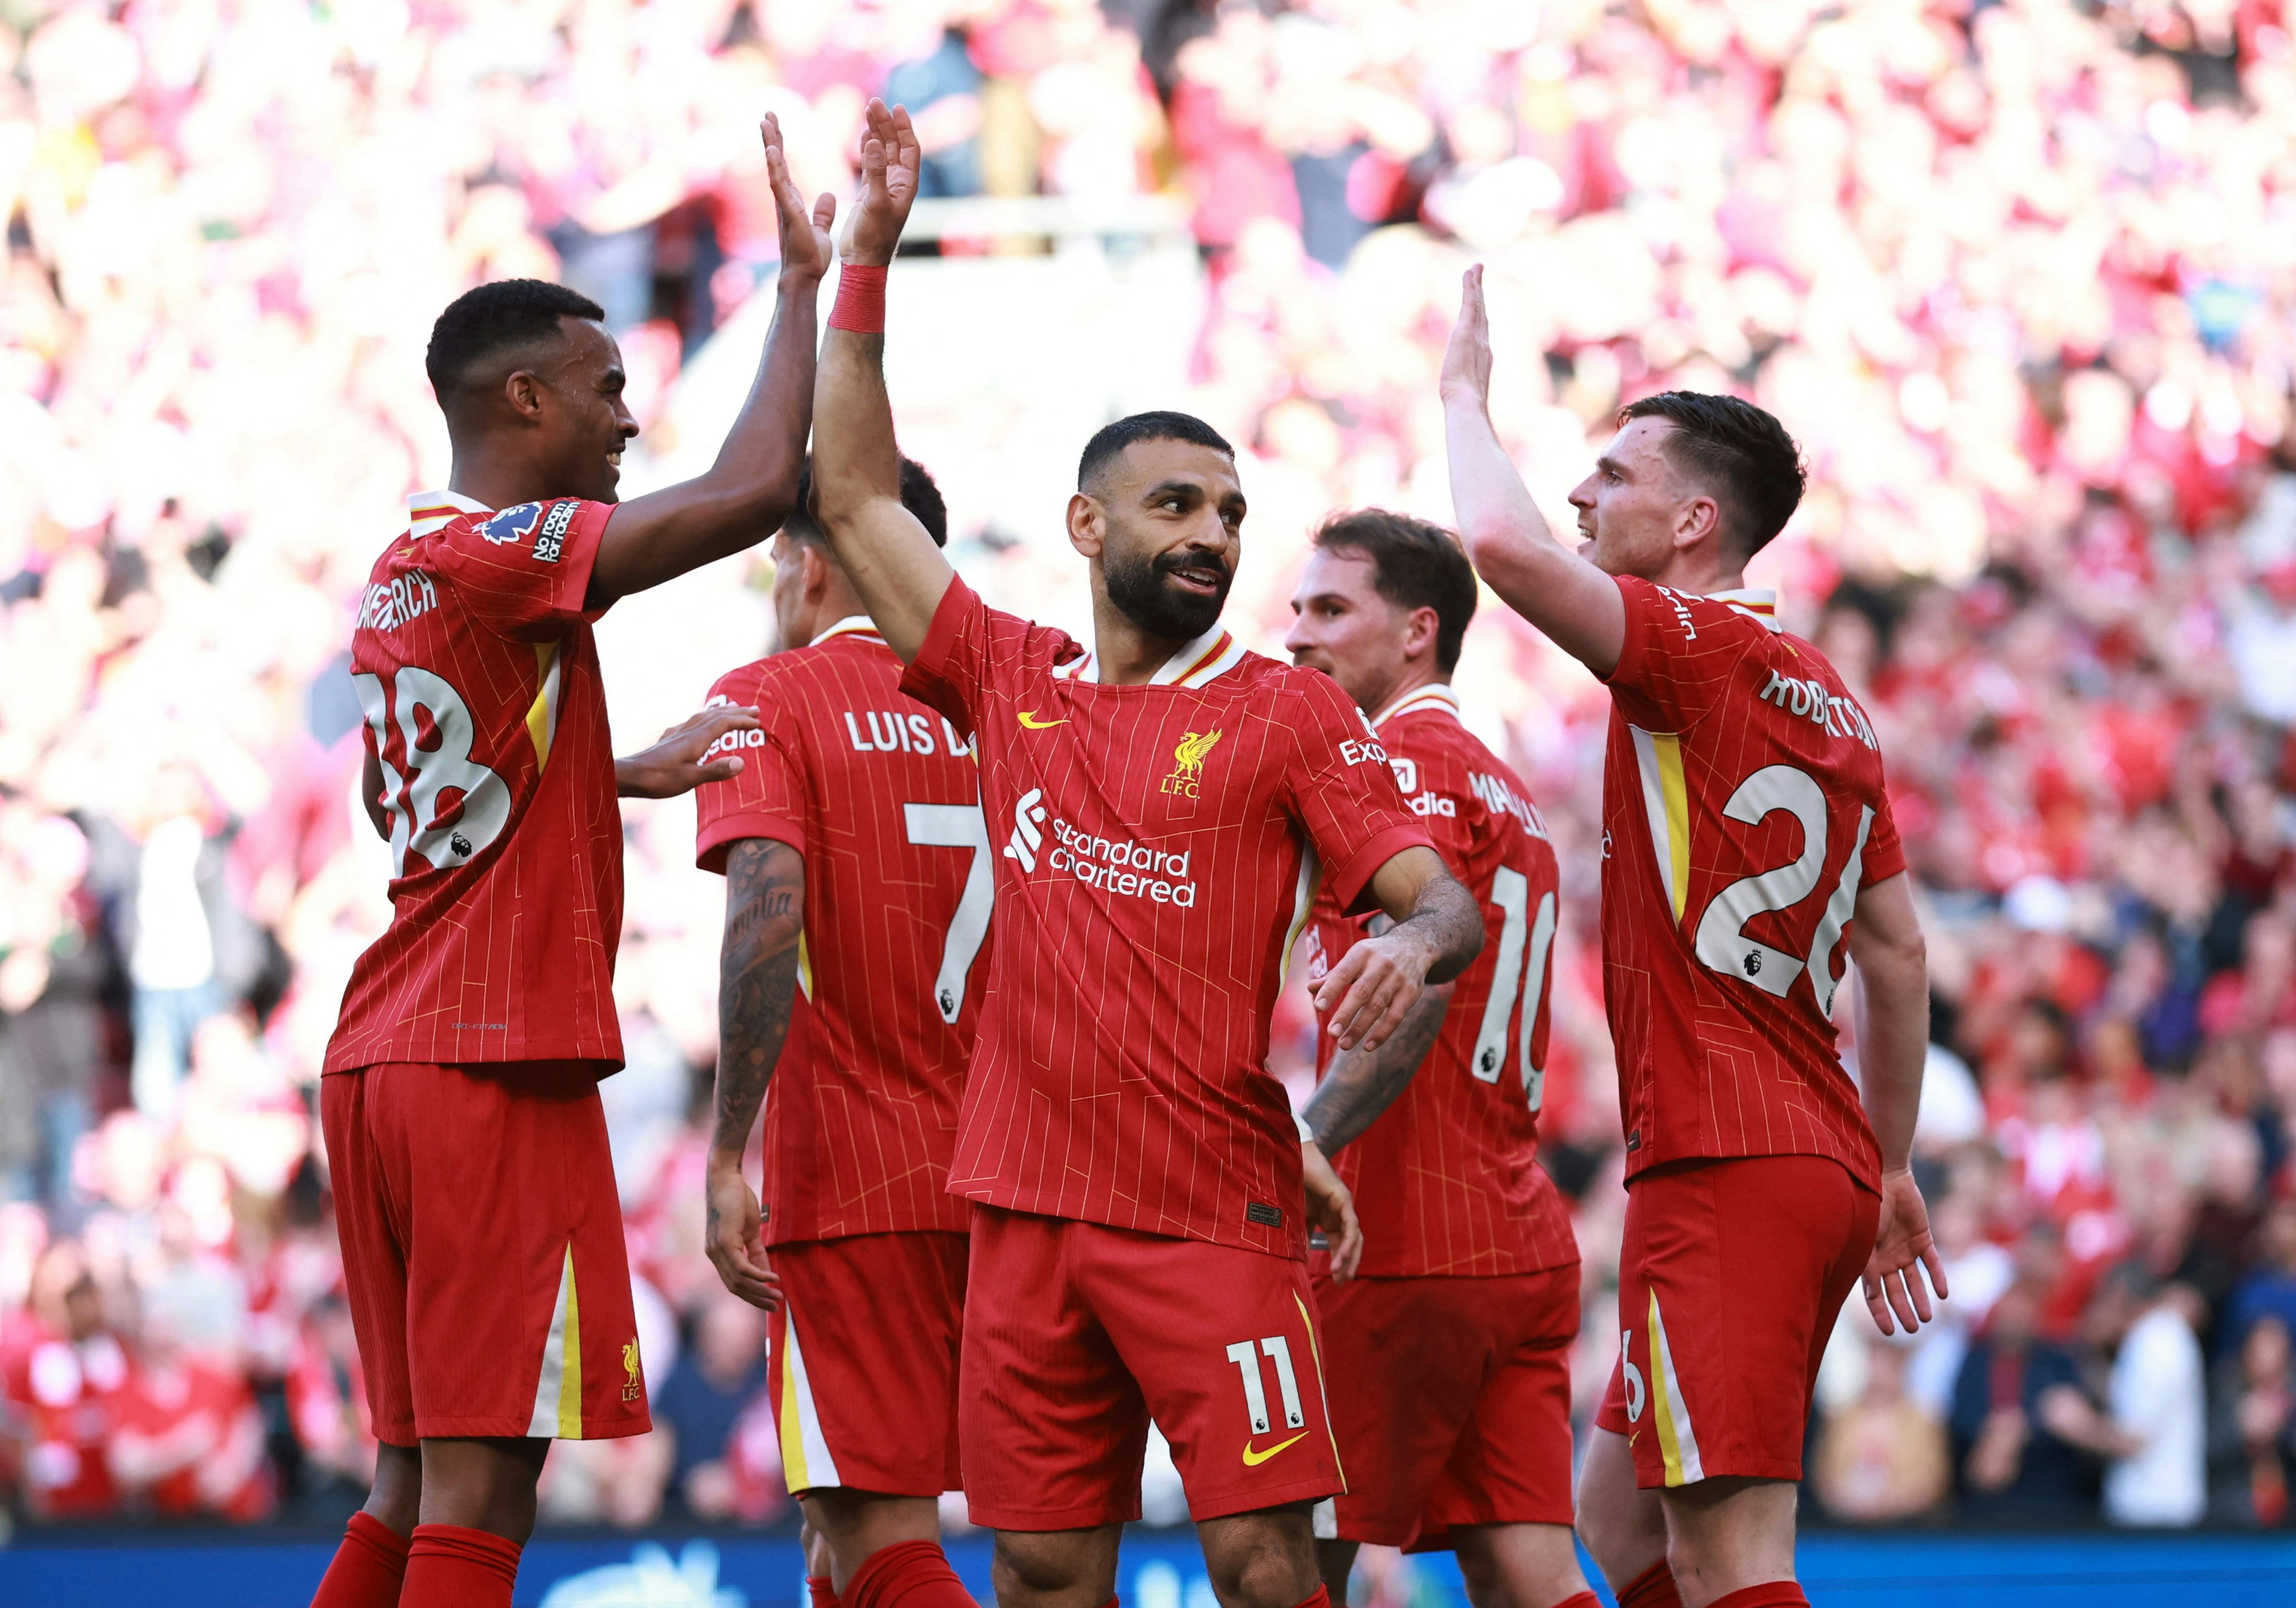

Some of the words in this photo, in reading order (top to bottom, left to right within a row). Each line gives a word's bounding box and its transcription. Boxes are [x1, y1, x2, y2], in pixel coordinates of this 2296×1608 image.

[532, 537, 550, 561] No
[541, 502, 567, 536] room
[545, 540, 561, 563] for
[553, 502, 581, 540] racism
[843, 710, 936, 756] LUIS
[1049, 845, 1197, 909] chartered
[1053, 818, 1190, 878] standard
[903, 802, 995, 1025] 7
[1226, 1335, 1306, 1435] 11
[1622, 1329, 1646, 1424] 6
